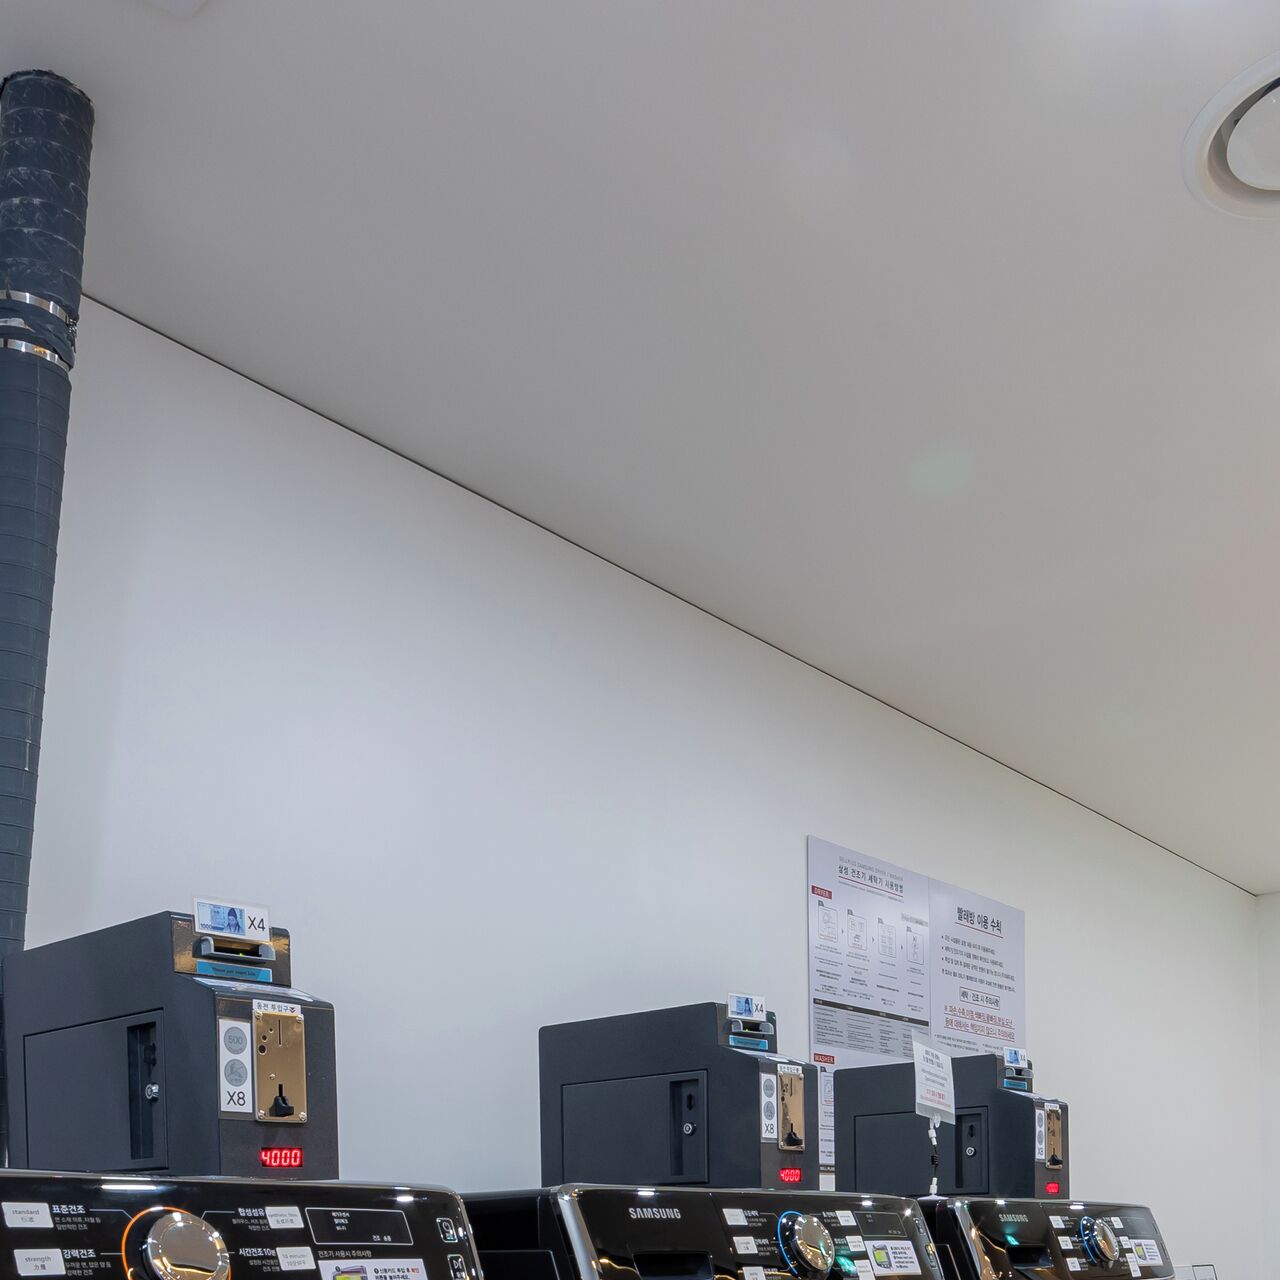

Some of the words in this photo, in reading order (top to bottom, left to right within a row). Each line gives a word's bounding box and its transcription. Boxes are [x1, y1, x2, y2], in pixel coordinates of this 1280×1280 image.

[248, 915, 266, 931] X4
[977, 914, 989, 930] 이용
[990, 918, 1002, 934] 수칙
[754, 1002, 764, 1014] X4
[227, 1034, 244, 1046] 500
[226, 1090, 246, 1107] X8
[764, 1123, 775, 1135] X8
[260, 1149, 301, 1166] 4000
[780, 1169, 801, 1182] 4000
[52, 1204, 86, 1214] 표준건조
[628, 1207, 681, 1220] SAMSUNG
[999, 1213, 1028, 1223] SAMSUNG
[62, 1249, 96, 1259] 강력건조
[239, 1247, 264, 1257] 시간건조
